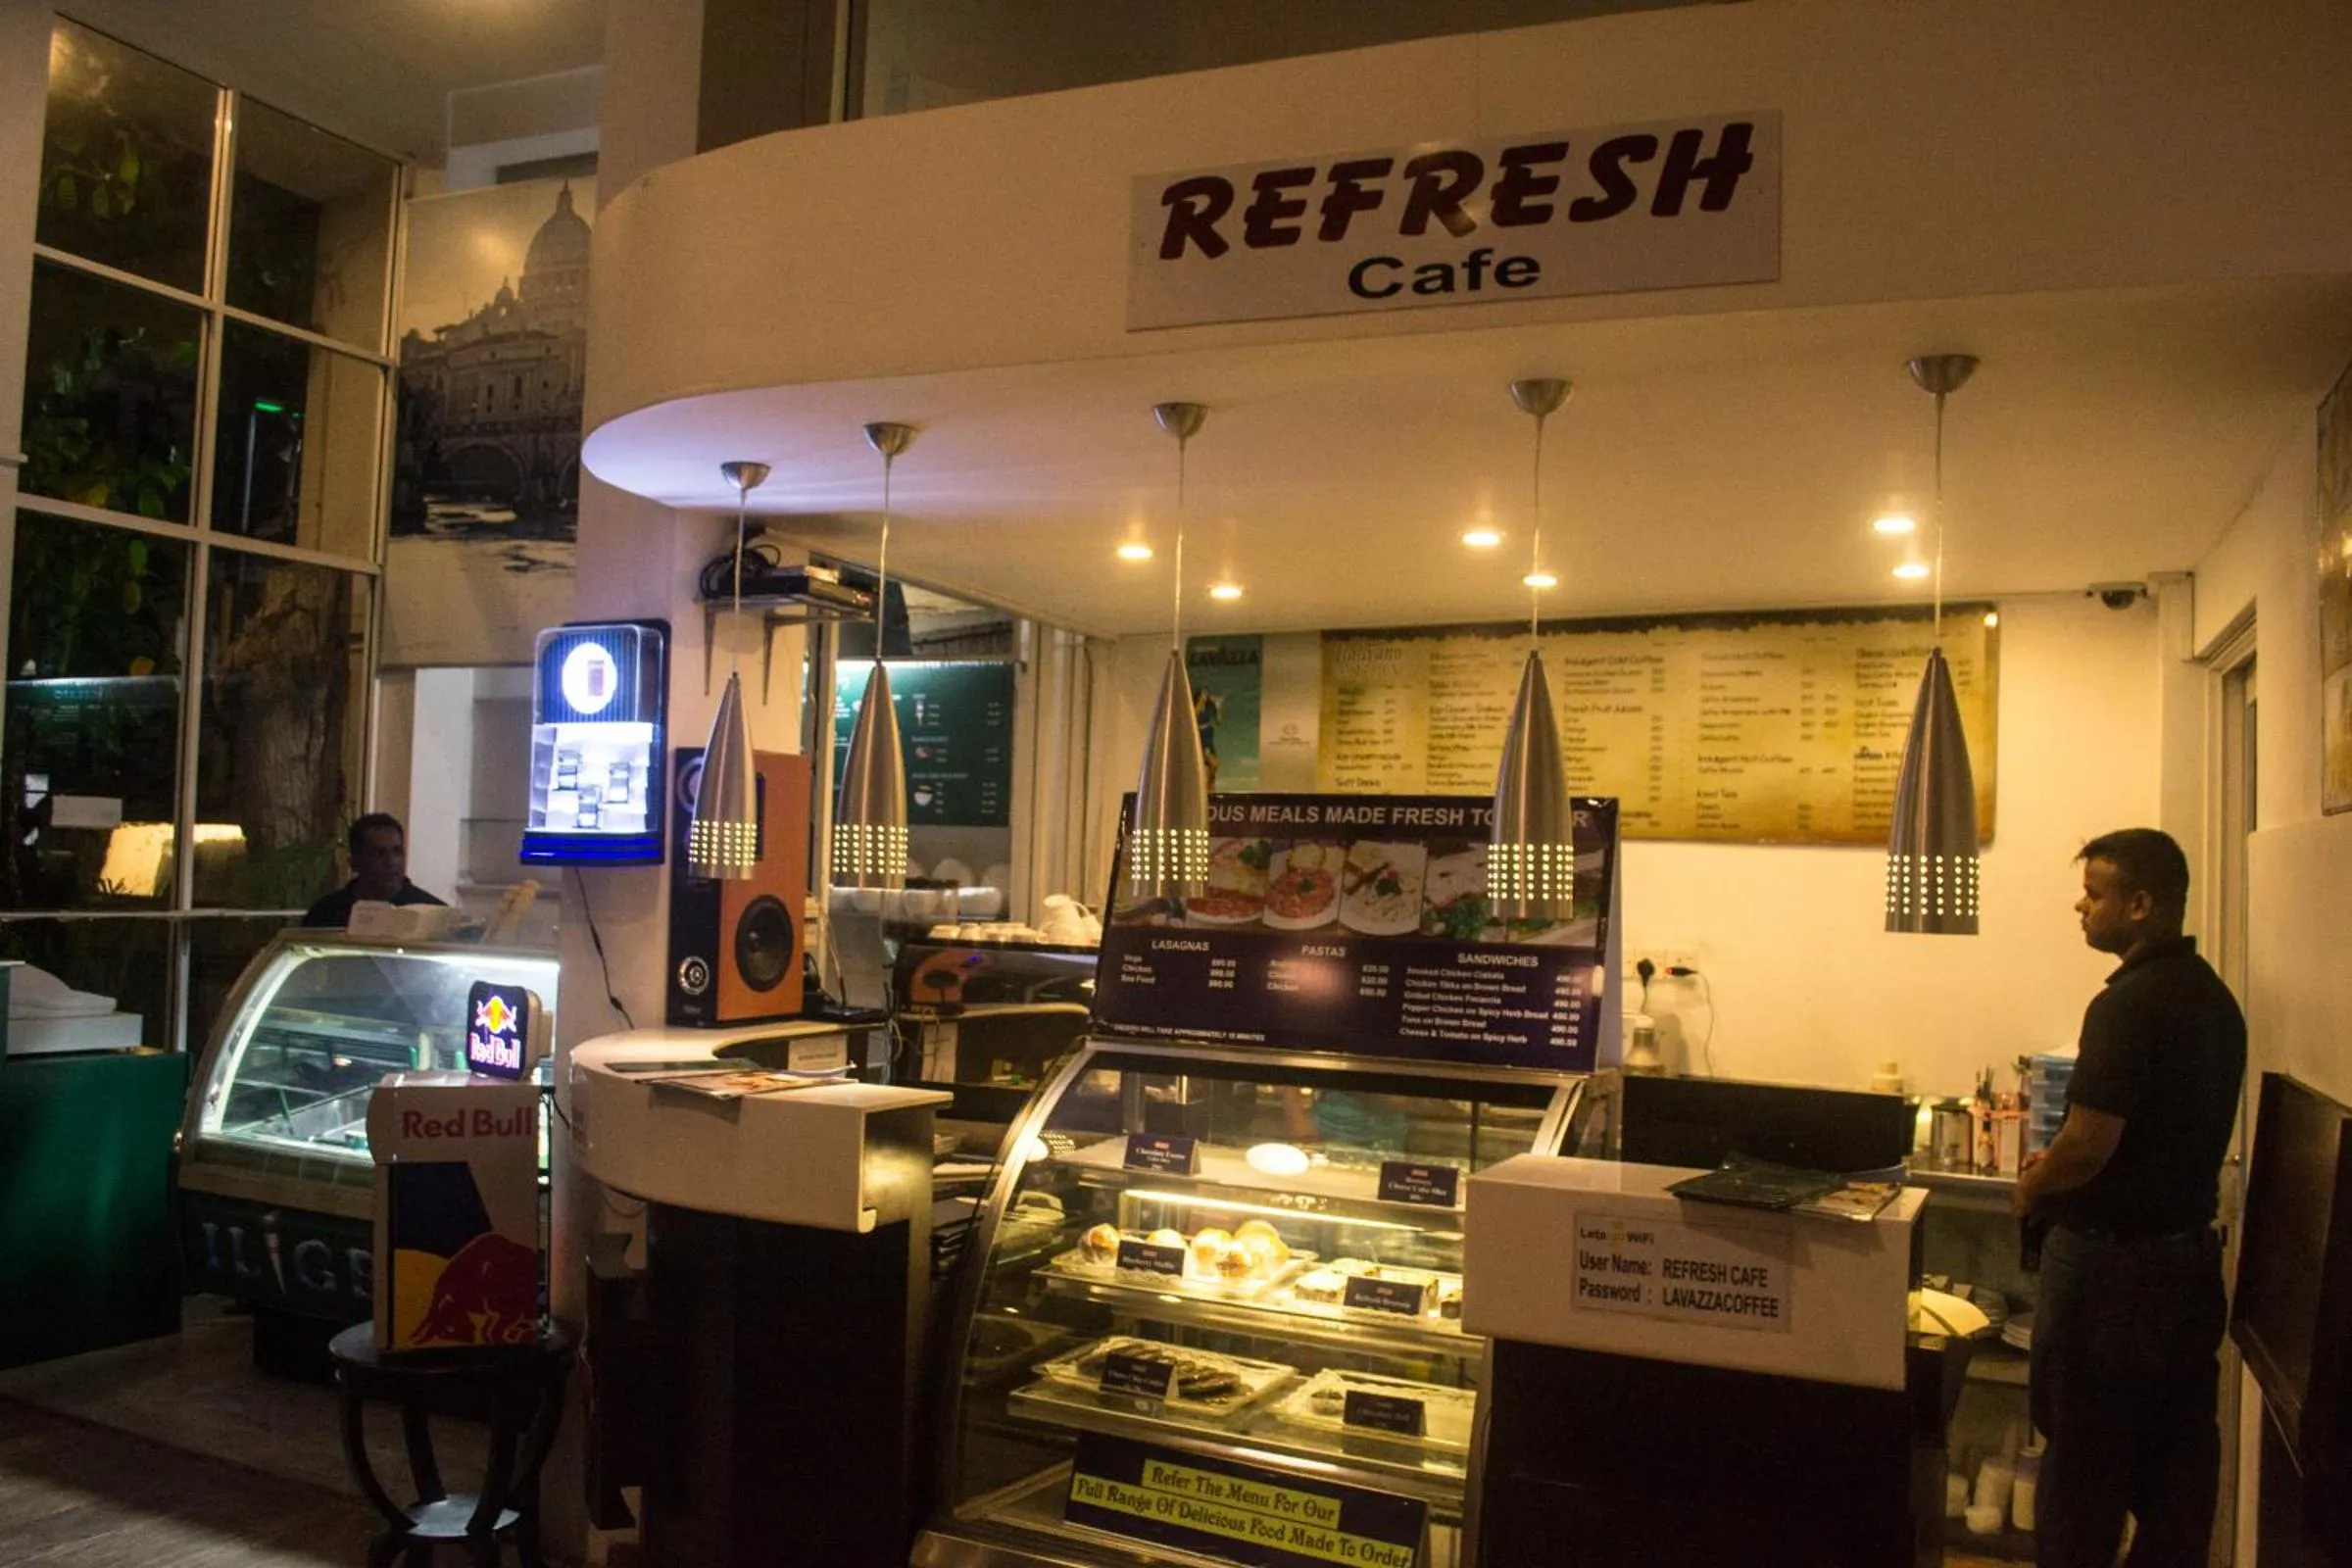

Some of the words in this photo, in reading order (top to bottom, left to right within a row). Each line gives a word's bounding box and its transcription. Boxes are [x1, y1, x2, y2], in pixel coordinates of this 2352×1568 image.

[1159, 122, 1753, 260] REFRESH
[1348, 248, 1541, 299] Cafe
[1249, 806, 1318, 823] MEALS
[1324, 808, 1385, 824] MADE
[1392, 809, 1464, 826] FRESH
[1152, 940, 1210, 952] LASAGNAS
[1301, 945, 1347, 957] PASTAS
[1457, 953, 1540, 967] SANDWICHES
[470, 1032, 495, 1064] Red
[495, 1036, 521, 1069] Bull
[403, 1106, 466, 1139] Red
[472, 1105, 533, 1136] Bull
[1580, 1250, 1609, 1271] User
[1612, 1253, 1652, 1275] Name:
[1662, 1257, 1728, 1284] REFRESH
[1730, 1264, 1769, 1288] CAFE
[1579, 1277, 1641, 1302] Password
[1662, 1287, 1780, 1318] LAVAZZACOFFEE
[1152, 1464, 1191, 1489] Refer
[1196, 1475, 1224, 1497] The
[1225, 1483, 1269, 1508] Menu
[1274, 1491, 1299, 1514] For
[1303, 1497, 1336, 1522] Our
[1076, 1477, 1103, 1500] Full
[1106, 1484, 1152, 1513] Range
[1155, 1494, 1175, 1515] Of
[1178, 1501, 1246, 1533] Delicious
[1249, 1516, 1286, 1541] Food
[1288, 1526, 1335, 1551] Made
[1338, 1535, 1357, 1556] To
